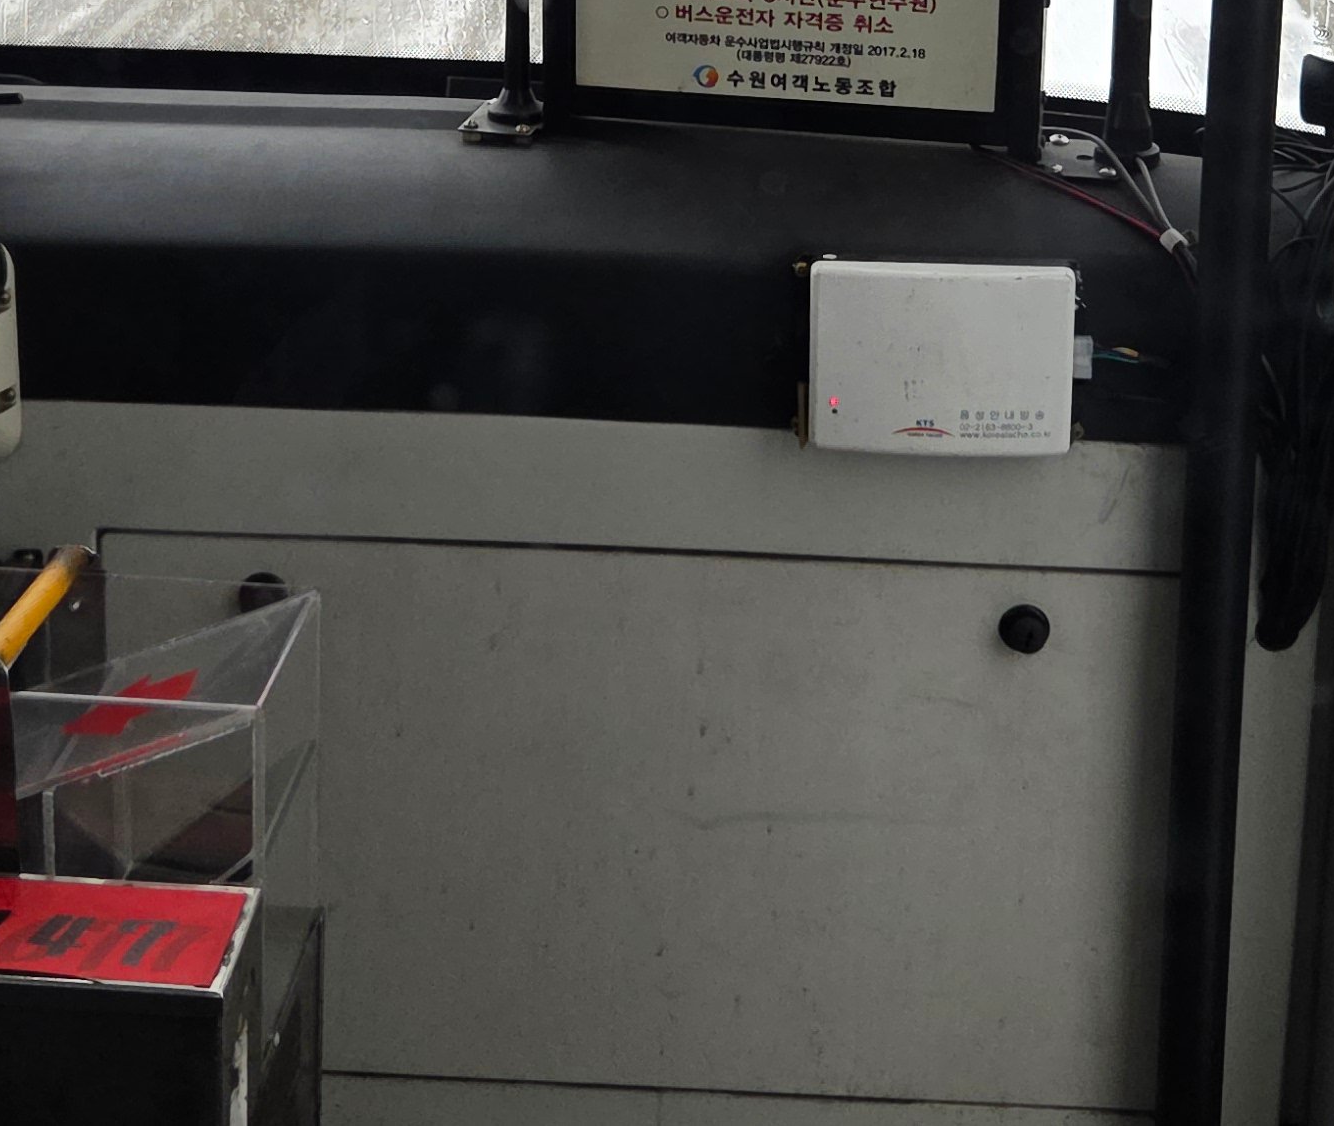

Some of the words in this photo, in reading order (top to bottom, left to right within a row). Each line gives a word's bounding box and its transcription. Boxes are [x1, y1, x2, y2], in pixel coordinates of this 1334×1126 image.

[675, 4, 775, 27] 버스운전자
[783, 10, 844, 32] 자격증
[853, 13, 895, 34] 취소
[665, 32, 721, 47] 여객자동차
[829, 42, 864, 56] 개정일
[867, 45, 927, 59] 2017.2.18
[726, 70, 898, 98] 수원여객노동조합
[916, 419, 935, 427] KTS
